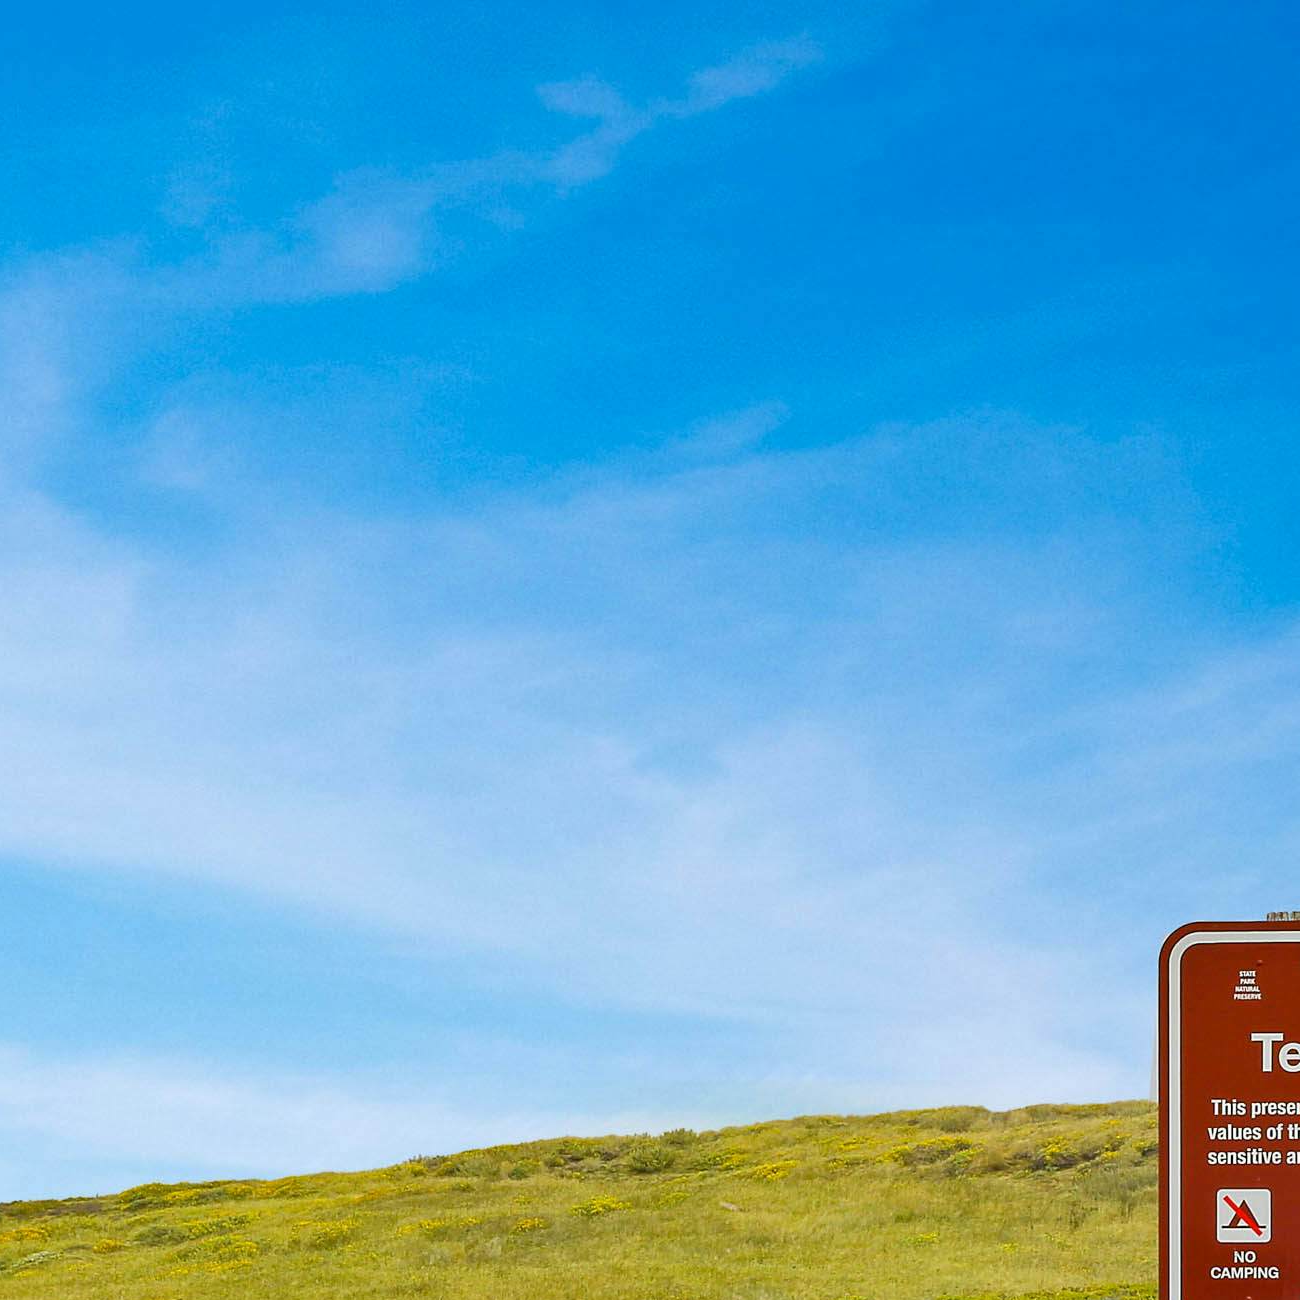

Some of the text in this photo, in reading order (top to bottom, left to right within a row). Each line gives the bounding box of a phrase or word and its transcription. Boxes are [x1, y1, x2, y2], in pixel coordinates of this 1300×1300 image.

[1235, 985, 1261, 993] NATURAL
[1210, 1098, 1247, 1116] This
[1207, 1123, 1262, 1140] values
[1266, 1123, 1284, 1140] of
[1207, 1147, 1282, 1165] sensitive
[1233, 1250, 1257, 1264] NO
[1210, 1266, 1279, 1279] CAMPING
